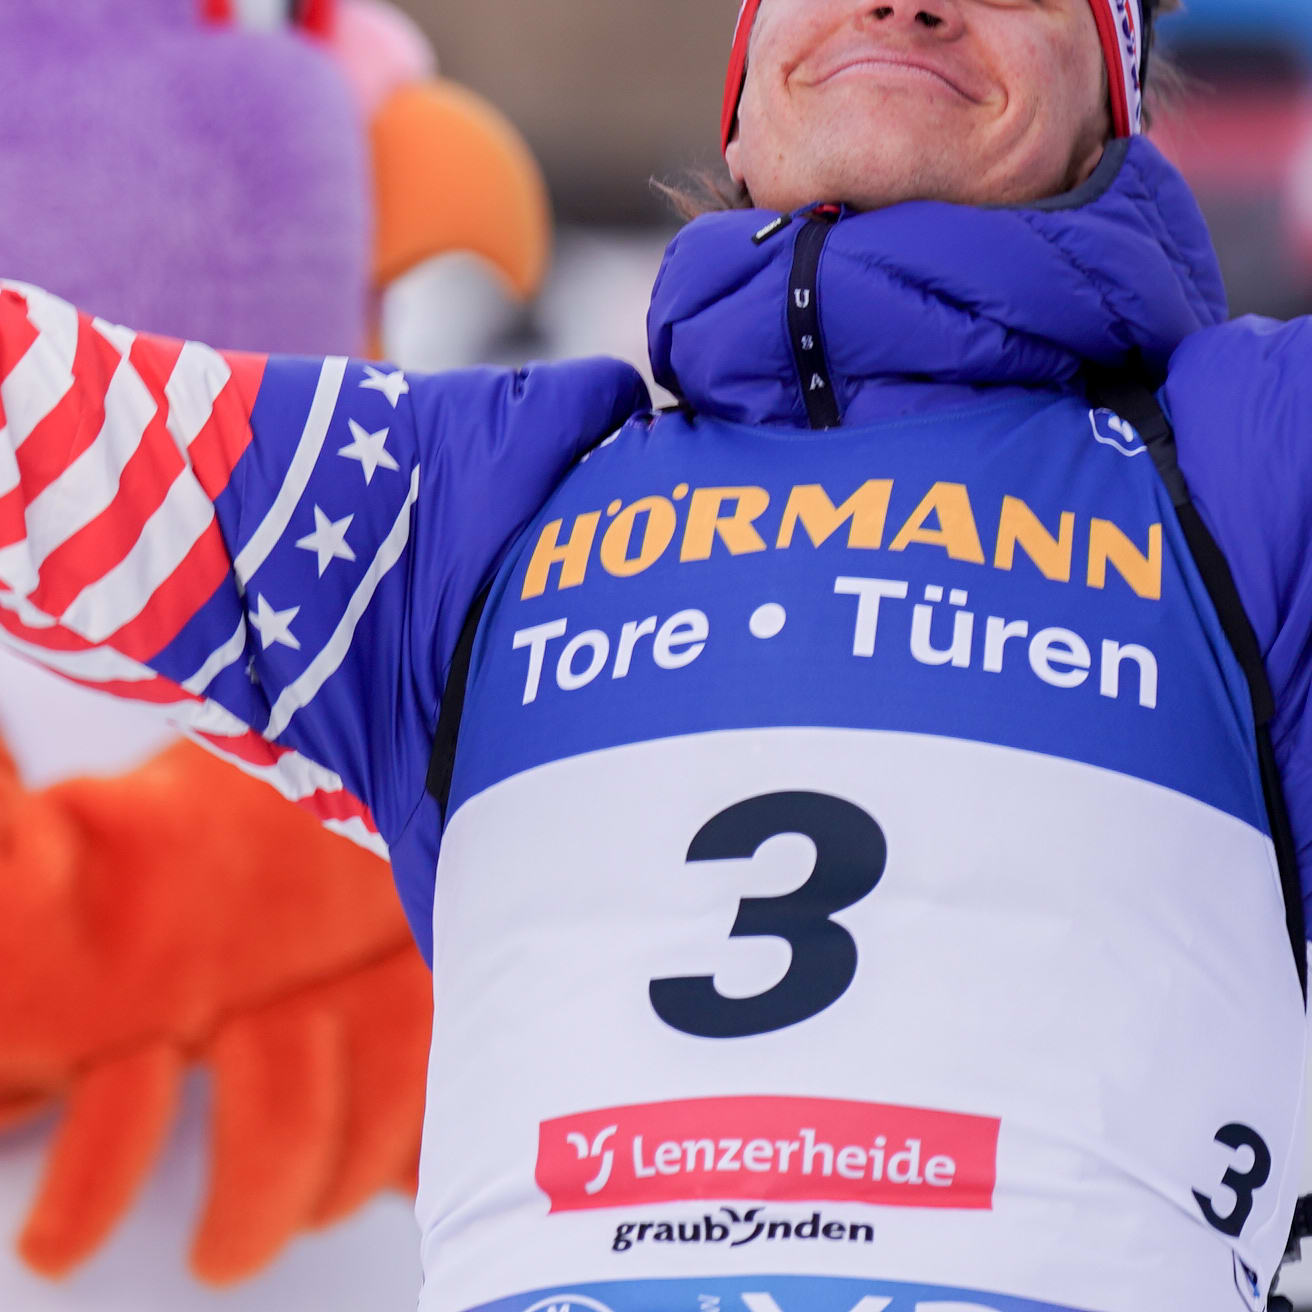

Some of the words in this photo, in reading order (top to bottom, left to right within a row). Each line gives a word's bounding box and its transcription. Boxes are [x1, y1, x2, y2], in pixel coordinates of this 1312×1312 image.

[520, 478, 1163, 600] HÖRMANN
[512, 606, 709, 705] Tore
[833, 577, 1159, 709] Türen
[648, 789, 888, 1039] 3
[633, 1128, 957, 1189] Lenzerheide
[1190, 1122, 1272, 1238] 3
